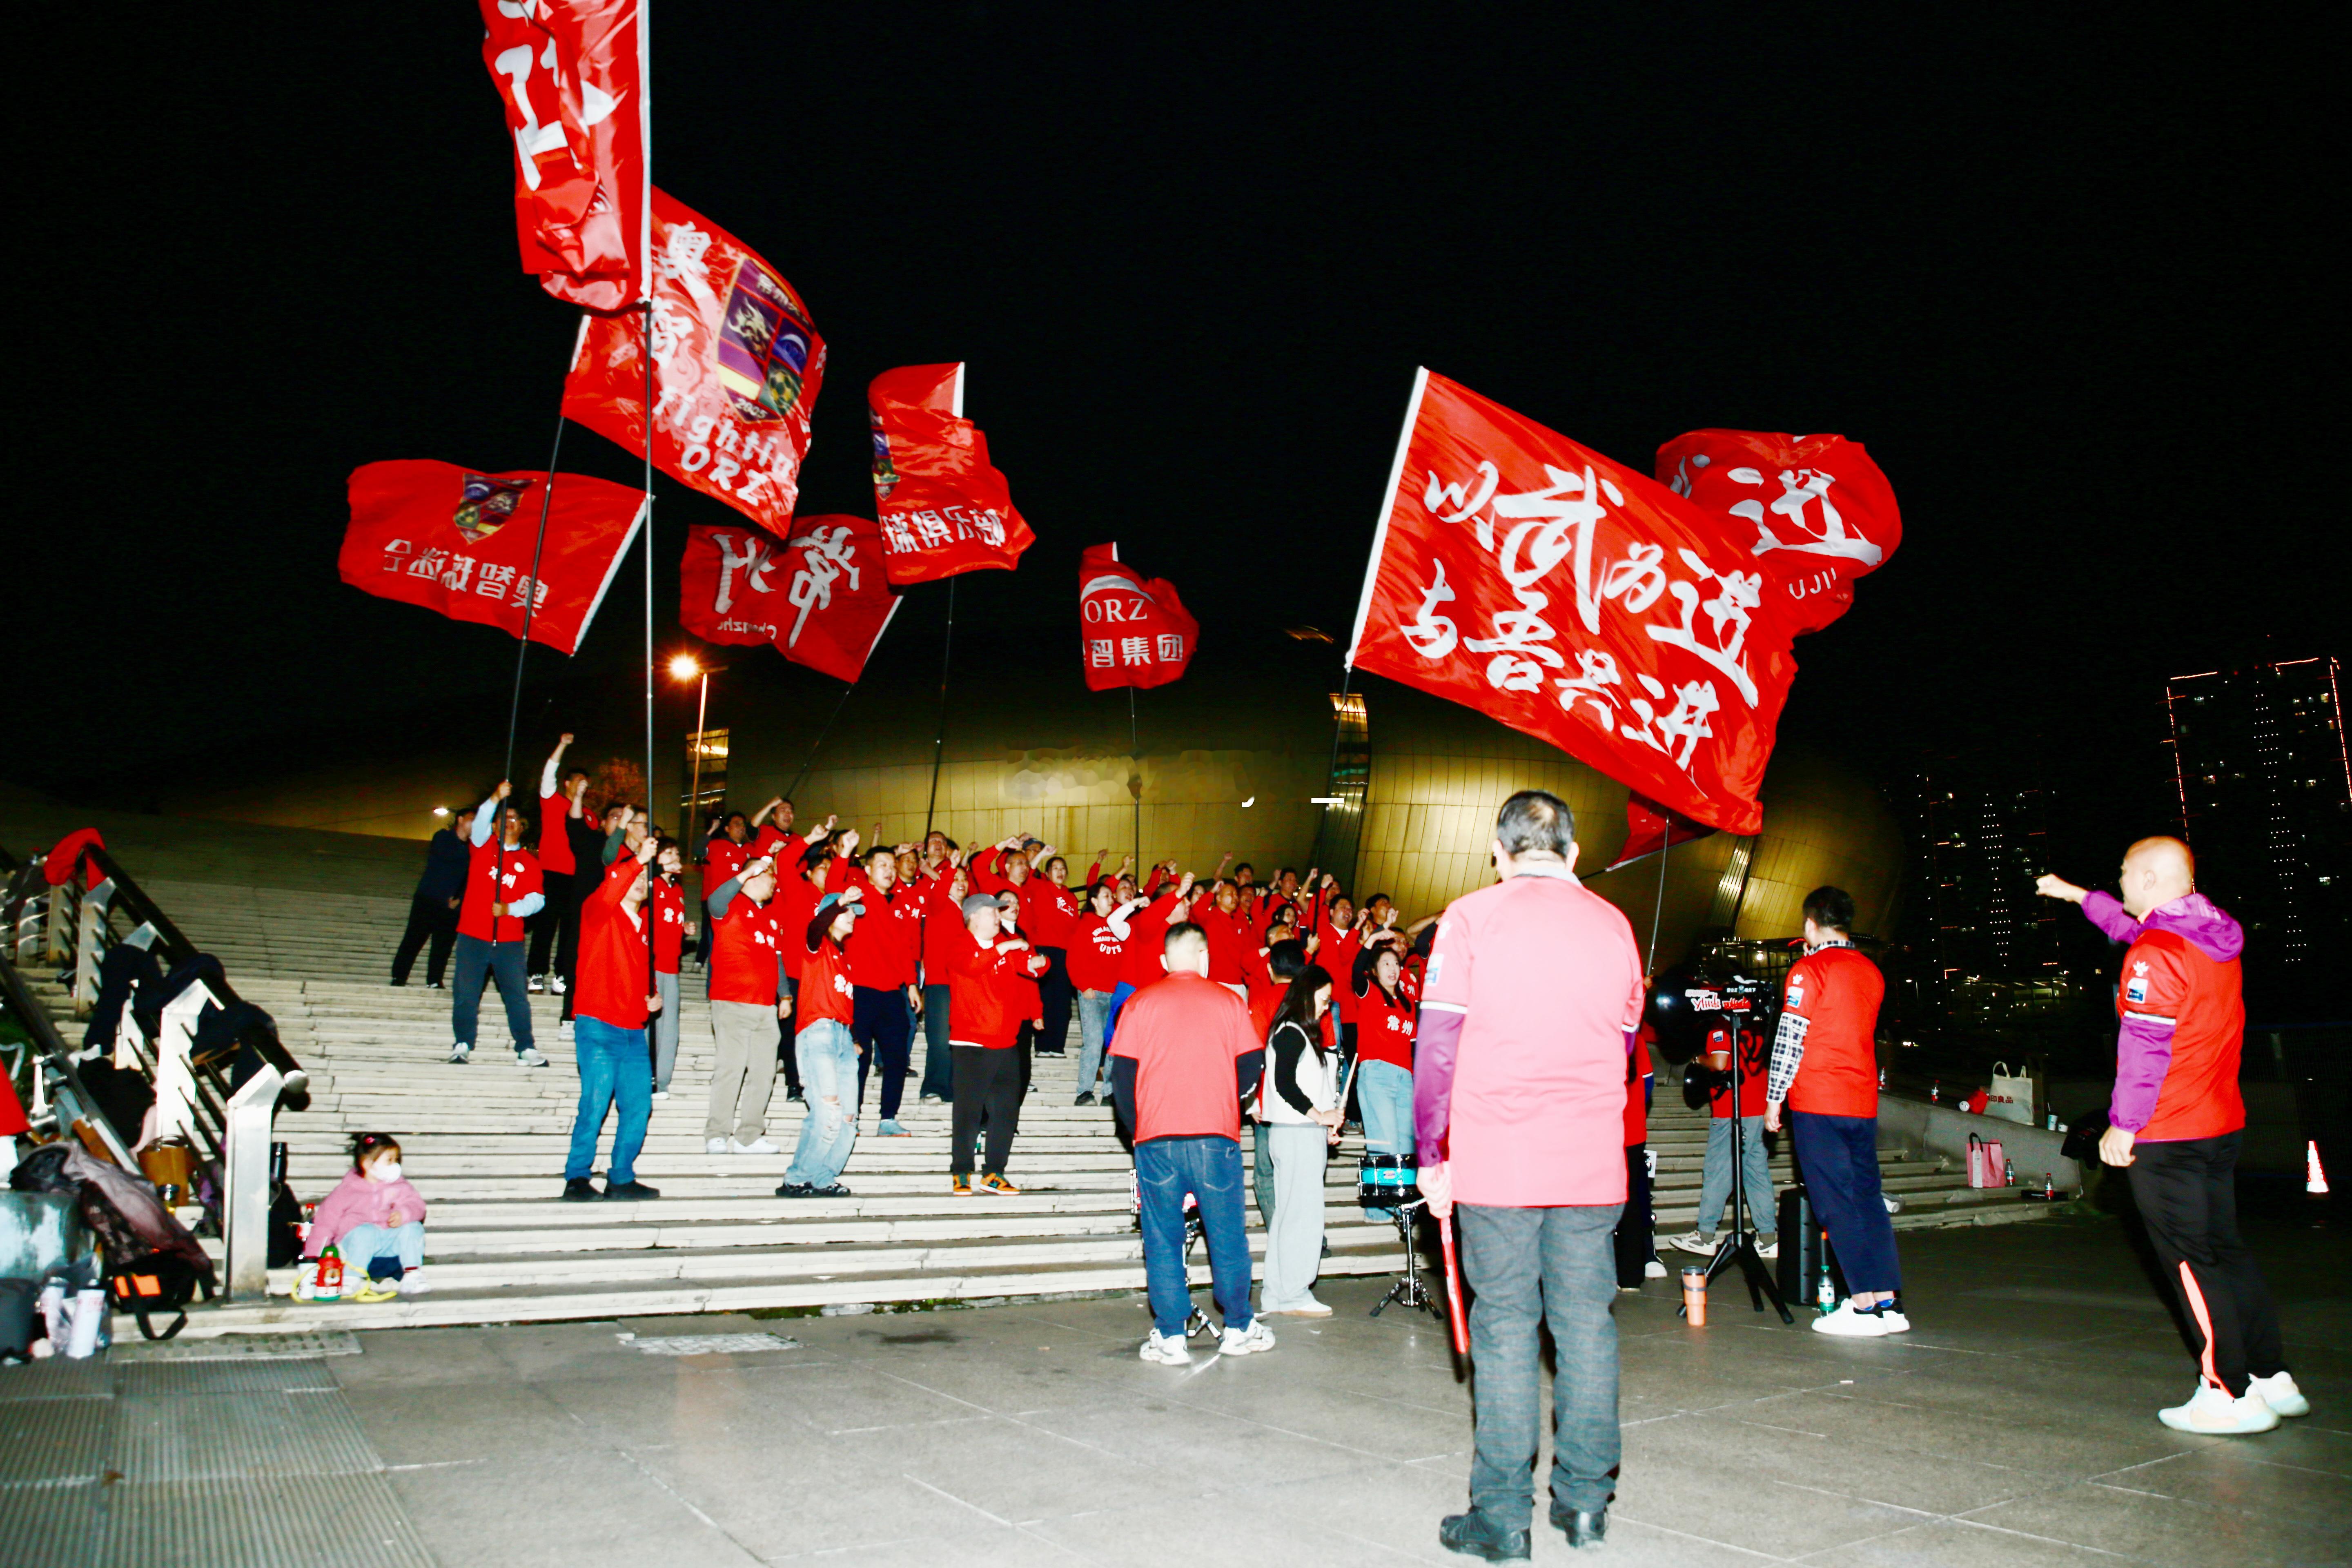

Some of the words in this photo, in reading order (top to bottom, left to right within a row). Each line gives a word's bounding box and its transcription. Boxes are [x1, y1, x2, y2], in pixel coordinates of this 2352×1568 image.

[735, 398, 768, 418] 2005
[682, 445, 767, 507] ORZ
[1084, 598, 1148, 624] ORZ
[1082, 633, 1183, 668] 智集团
[1387, 1015, 1413, 1036] 常州
